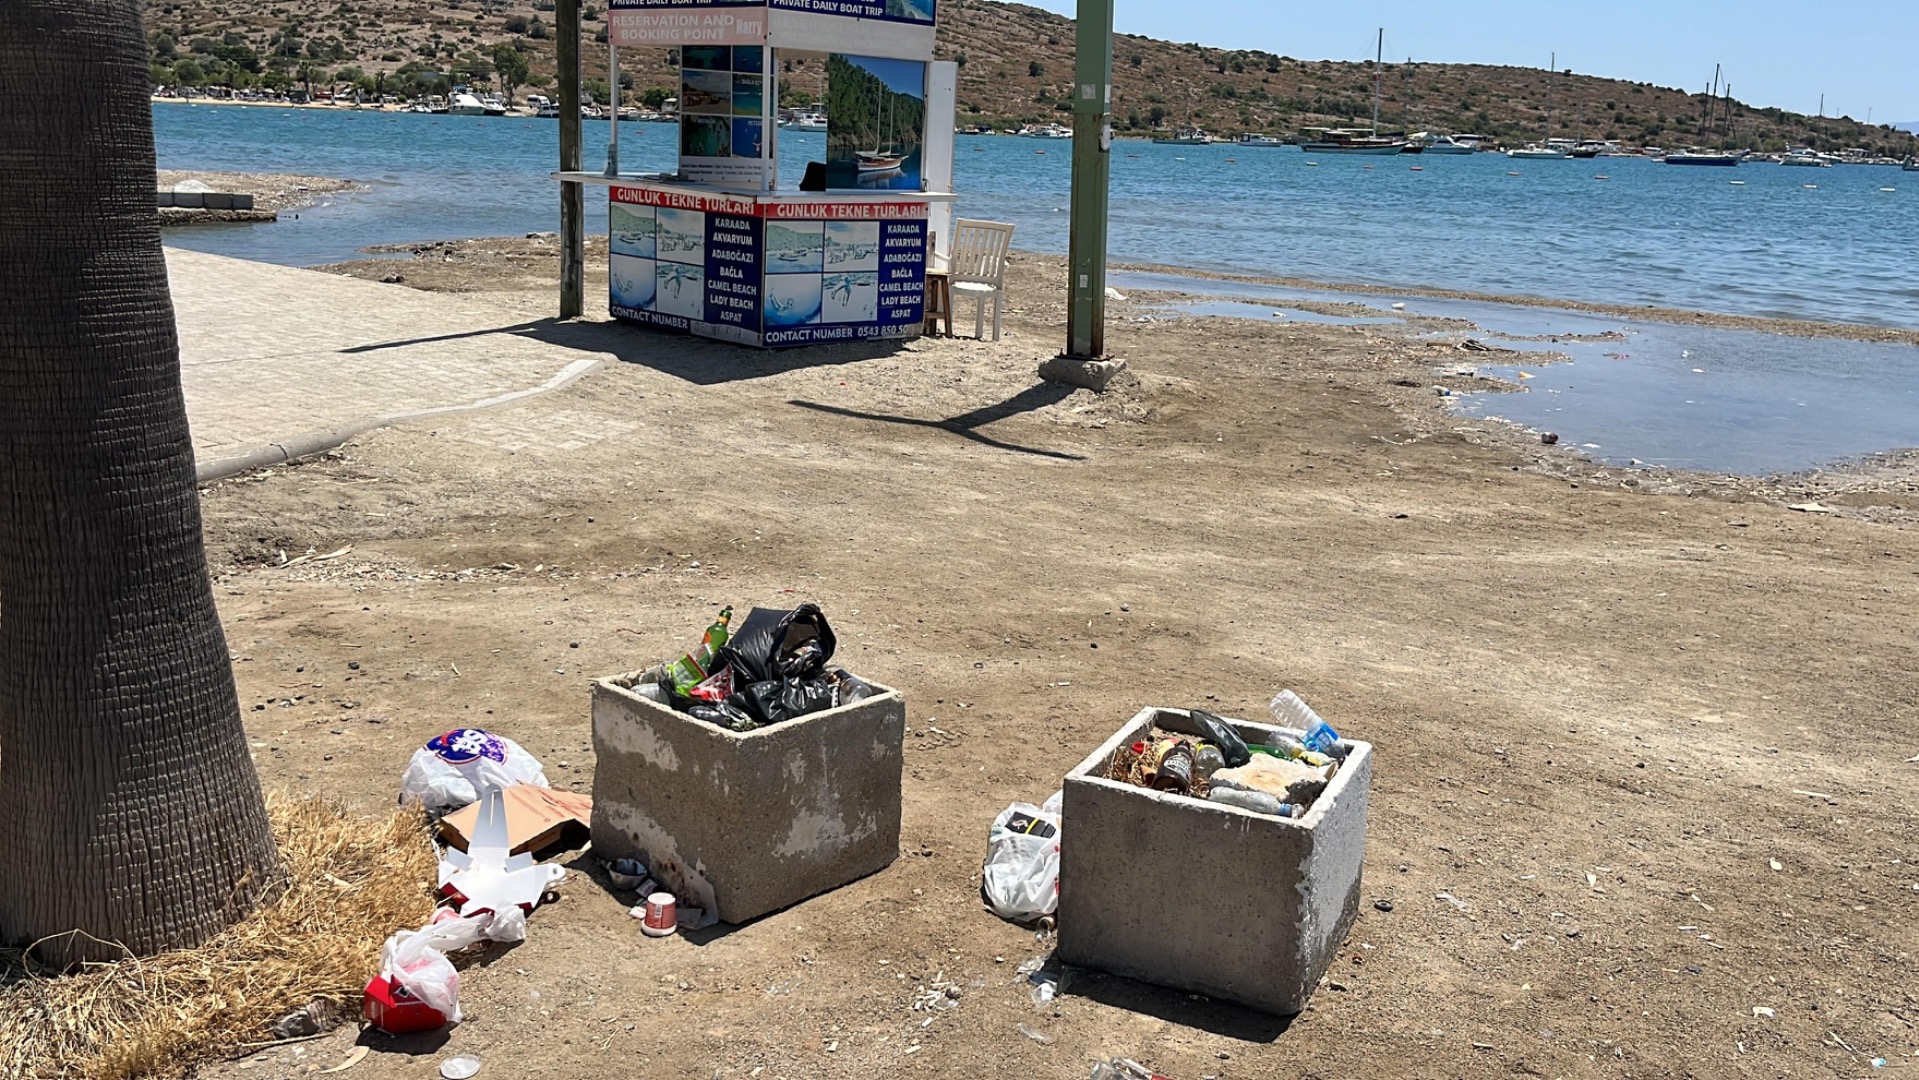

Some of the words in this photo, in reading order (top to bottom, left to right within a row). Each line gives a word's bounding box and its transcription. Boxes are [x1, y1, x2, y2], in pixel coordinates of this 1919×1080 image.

[812, 0, 838, 11] DAILY
[840, 3, 863, 14] BOAT
[865, 6, 883, 16] TRIP
[612, 15, 698, 26] RESERVATION
[703, 14, 734, 26] AND
[621, 29, 679, 40] BOOKING
[684, 29, 725, 40] POINT
[664, 193, 702, 209] TEKNE
[831, 205, 870, 218] TEKNE
[714, 217, 750, 231] KARAADA
[887, 224, 920, 234] KARAADA
[712, 232, 752, 246] AKVARYUM
[885, 238, 921, 248] AKVARYUM
[708, 279, 731, 292] CAMEL
[732, 283, 757, 295] BEACH
[879, 283, 902, 292] CAMEL
[903, 282, 923, 291] BEACH
[710, 294, 728, 306] LADY
[729, 298, 754, 310] BEACH
[881, 297, 899, 306] LADY
[900, 296, 921, 305] BEACH
[612, 306, 649, 322] CONTACT
[651, 313, 688, 329] NUMBER
[720, 310, 742, 322] ASPAT
[891, 309, 911, 319] ASPAT
[766, 329, 811, 343] CONTACT
[813, 327, 853, 339] NUMBER
[857, 326, 879, 337] 0543
